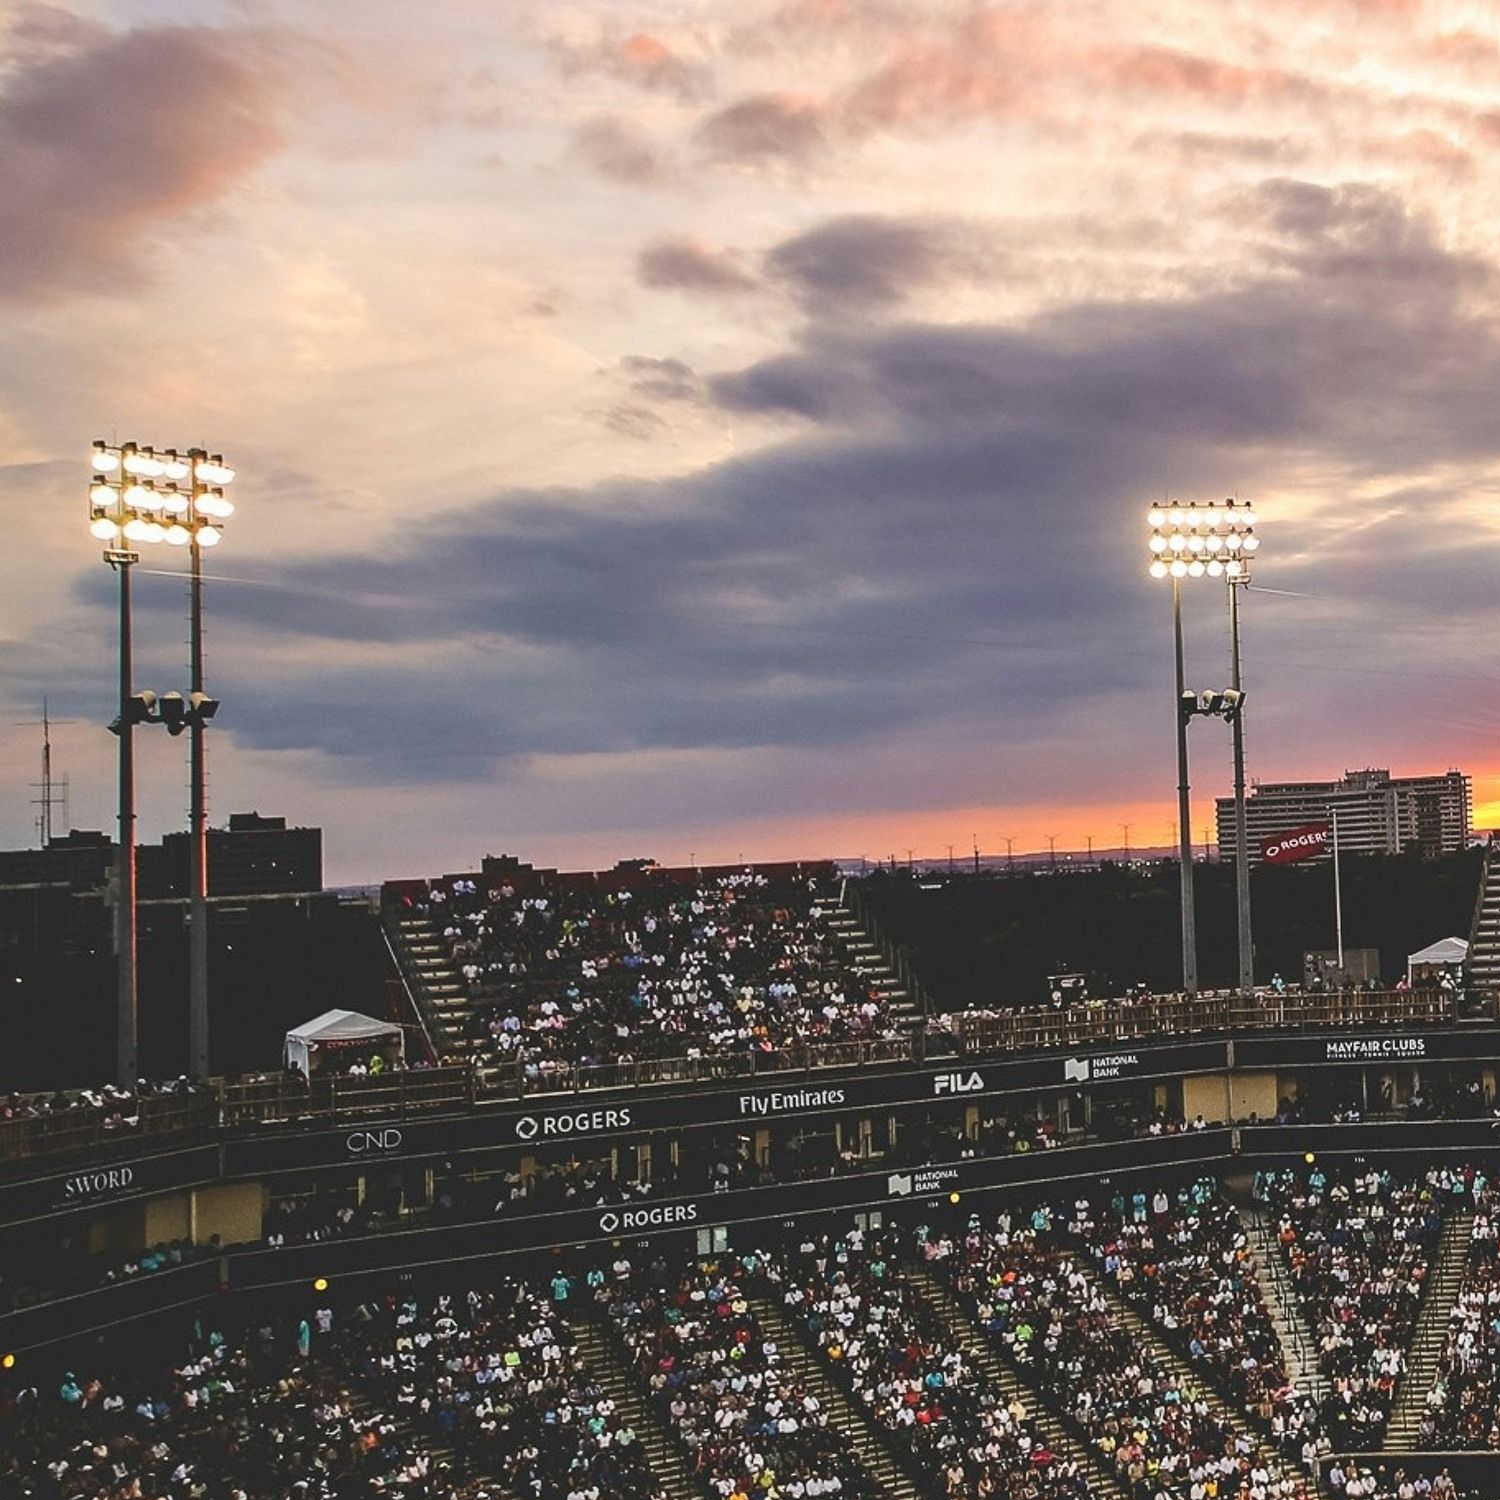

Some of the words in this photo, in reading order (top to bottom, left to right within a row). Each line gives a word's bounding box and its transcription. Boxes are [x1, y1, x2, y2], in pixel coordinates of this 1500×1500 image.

[1326, 1042, 1381, 1054] MAYFAIR
[1382, 1039, 1425, 1051] CLUBS
[1093, 1054, 1139, 1068] NATIONAL
[1093, 1066, 1120, 1078] BANK
[933, 1071, 985, 1094] FILA
[740, 1096, 769, 1115] Fly
[771, 1088, 845, 1111] Emirates
[543, 1108, 632, 1135] ROGERS
[346, 1129, 402, 1152] CND
[65, 1168, 133, 1198] SWORD
[913, 1169, 958, 1182] NATIONAL
[914, 1180, 940, 1192] BANK
[623, 1204, 697, 1228] ROGERS
